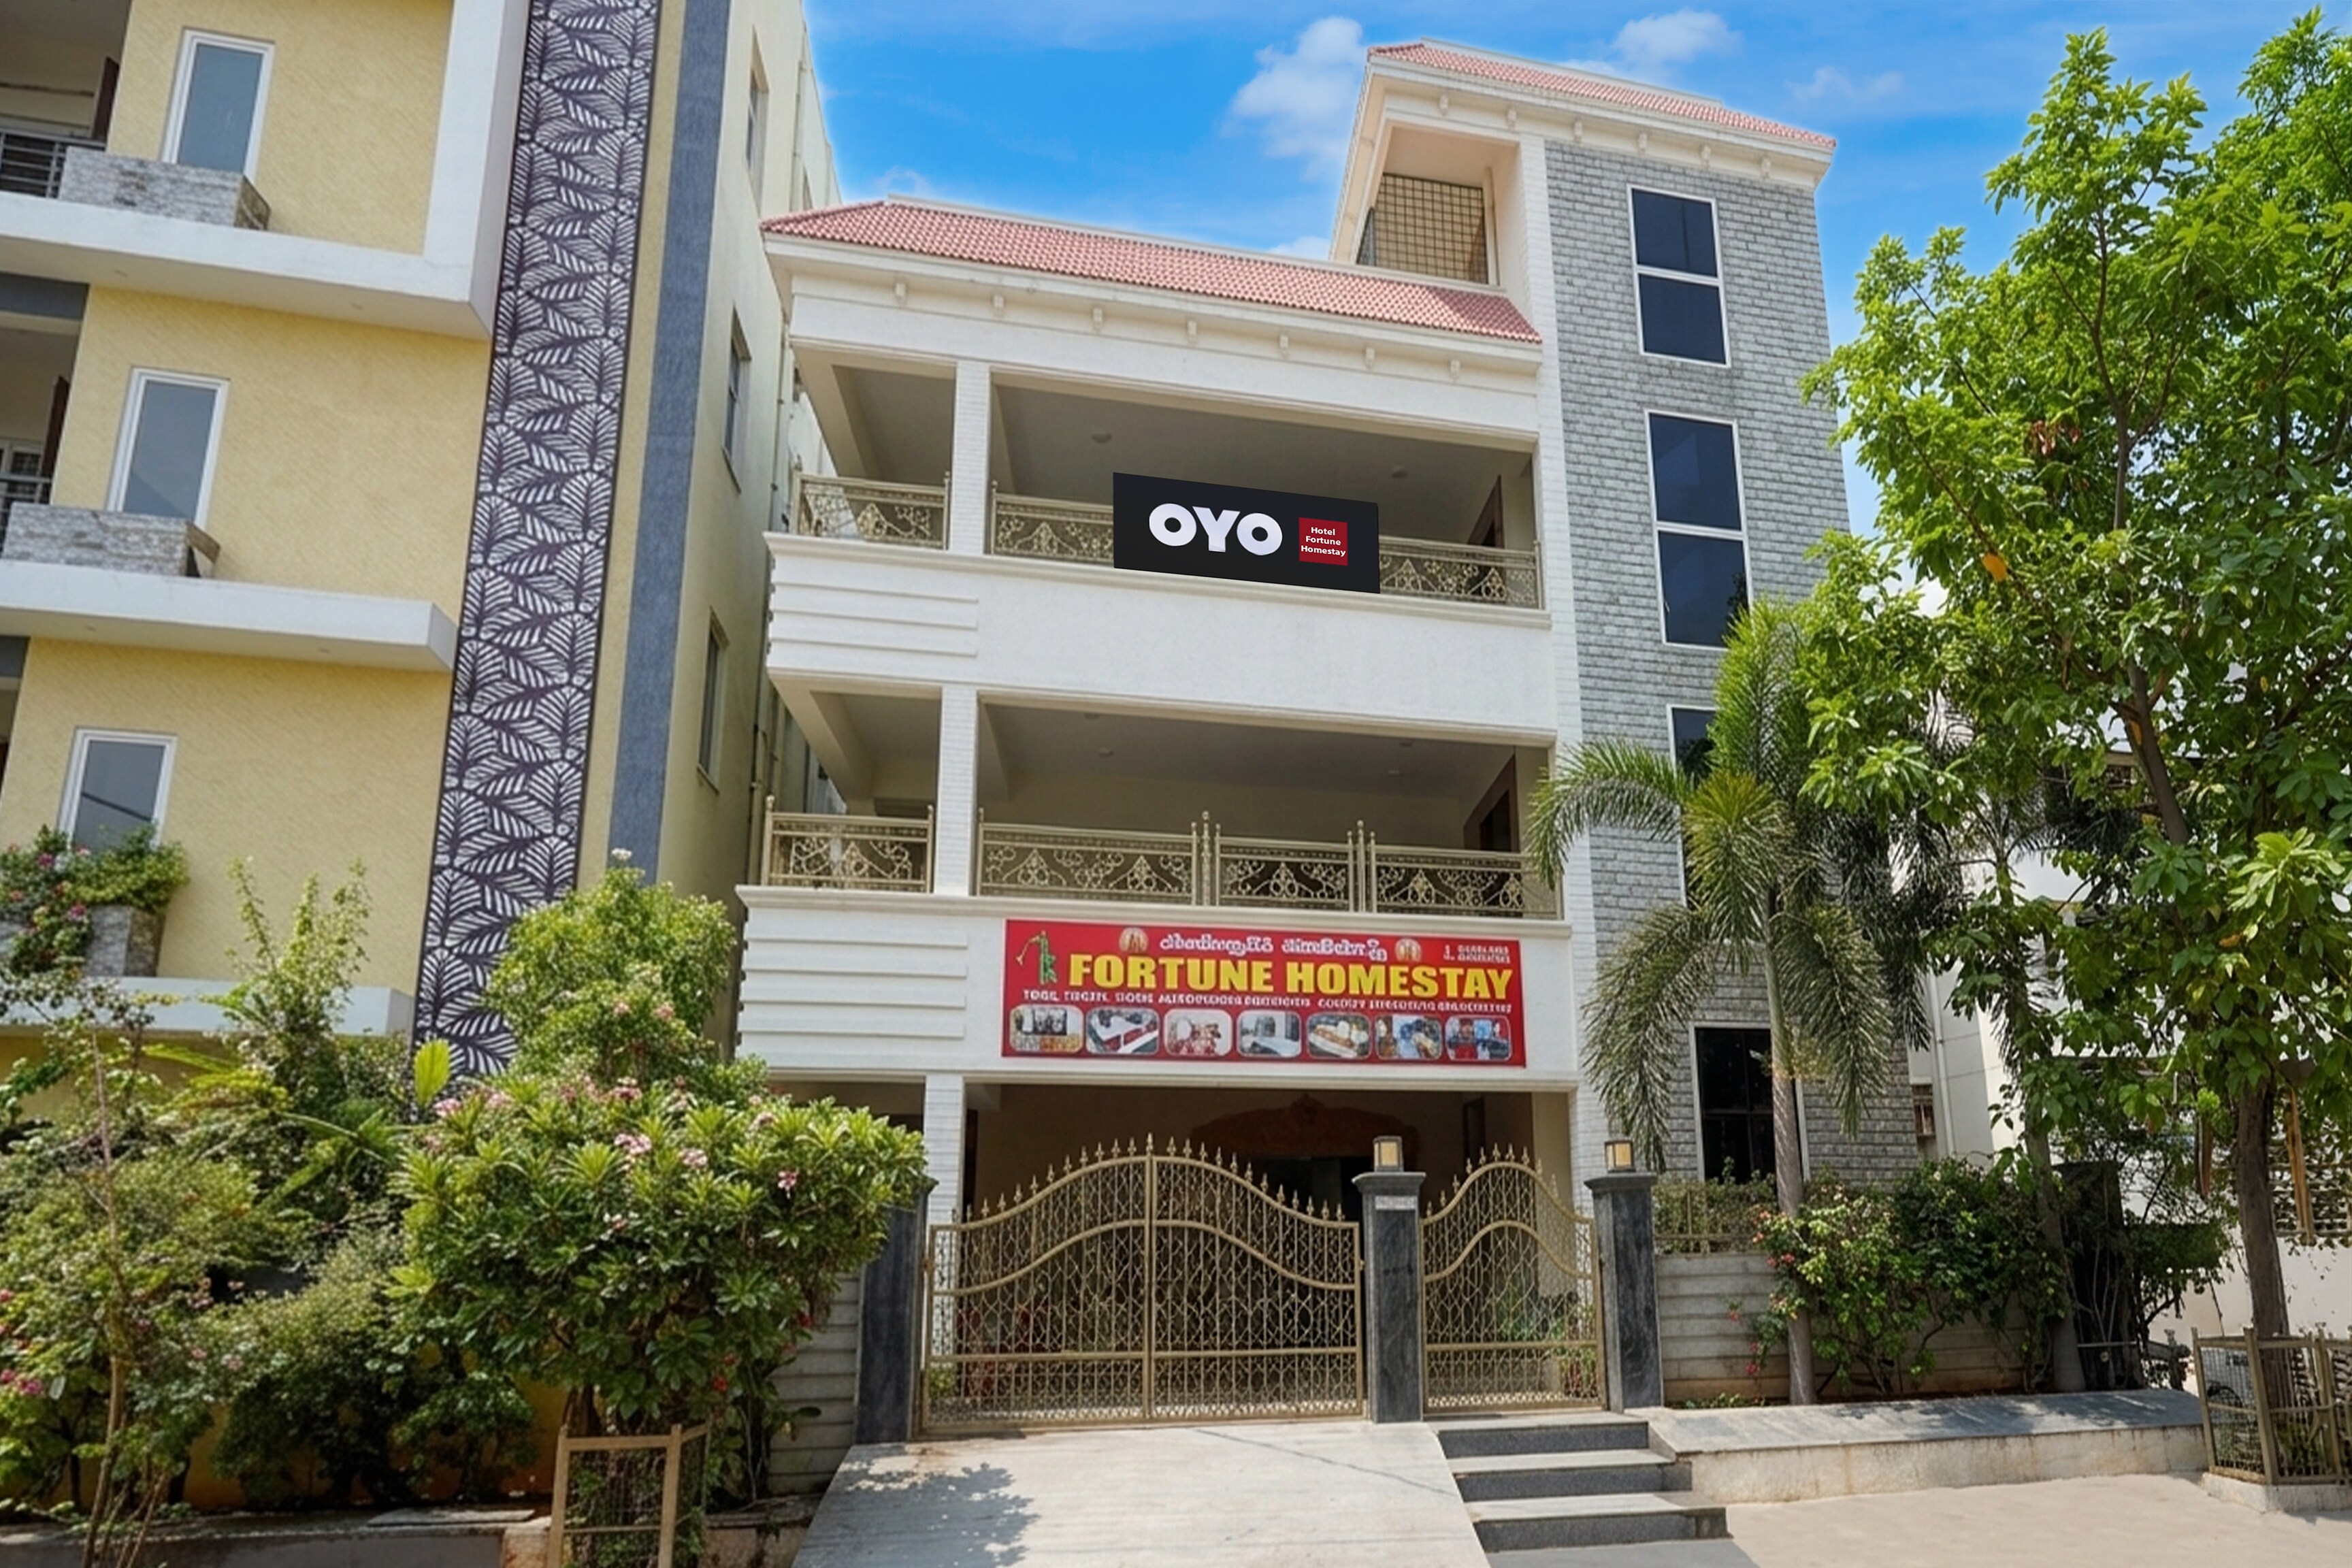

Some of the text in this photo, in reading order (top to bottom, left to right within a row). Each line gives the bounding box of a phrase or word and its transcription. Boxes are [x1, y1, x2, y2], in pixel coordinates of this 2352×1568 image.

[1149, 503, 1283, 556] OYO
[1311, 527, 1336, 536] Hotel
[1305, 536, 1341, 546] Fortune
[1301, 545, 1346, 557] Homestay
[1068, 953, 1514, 1000] FORTUNE HOMESTAY
